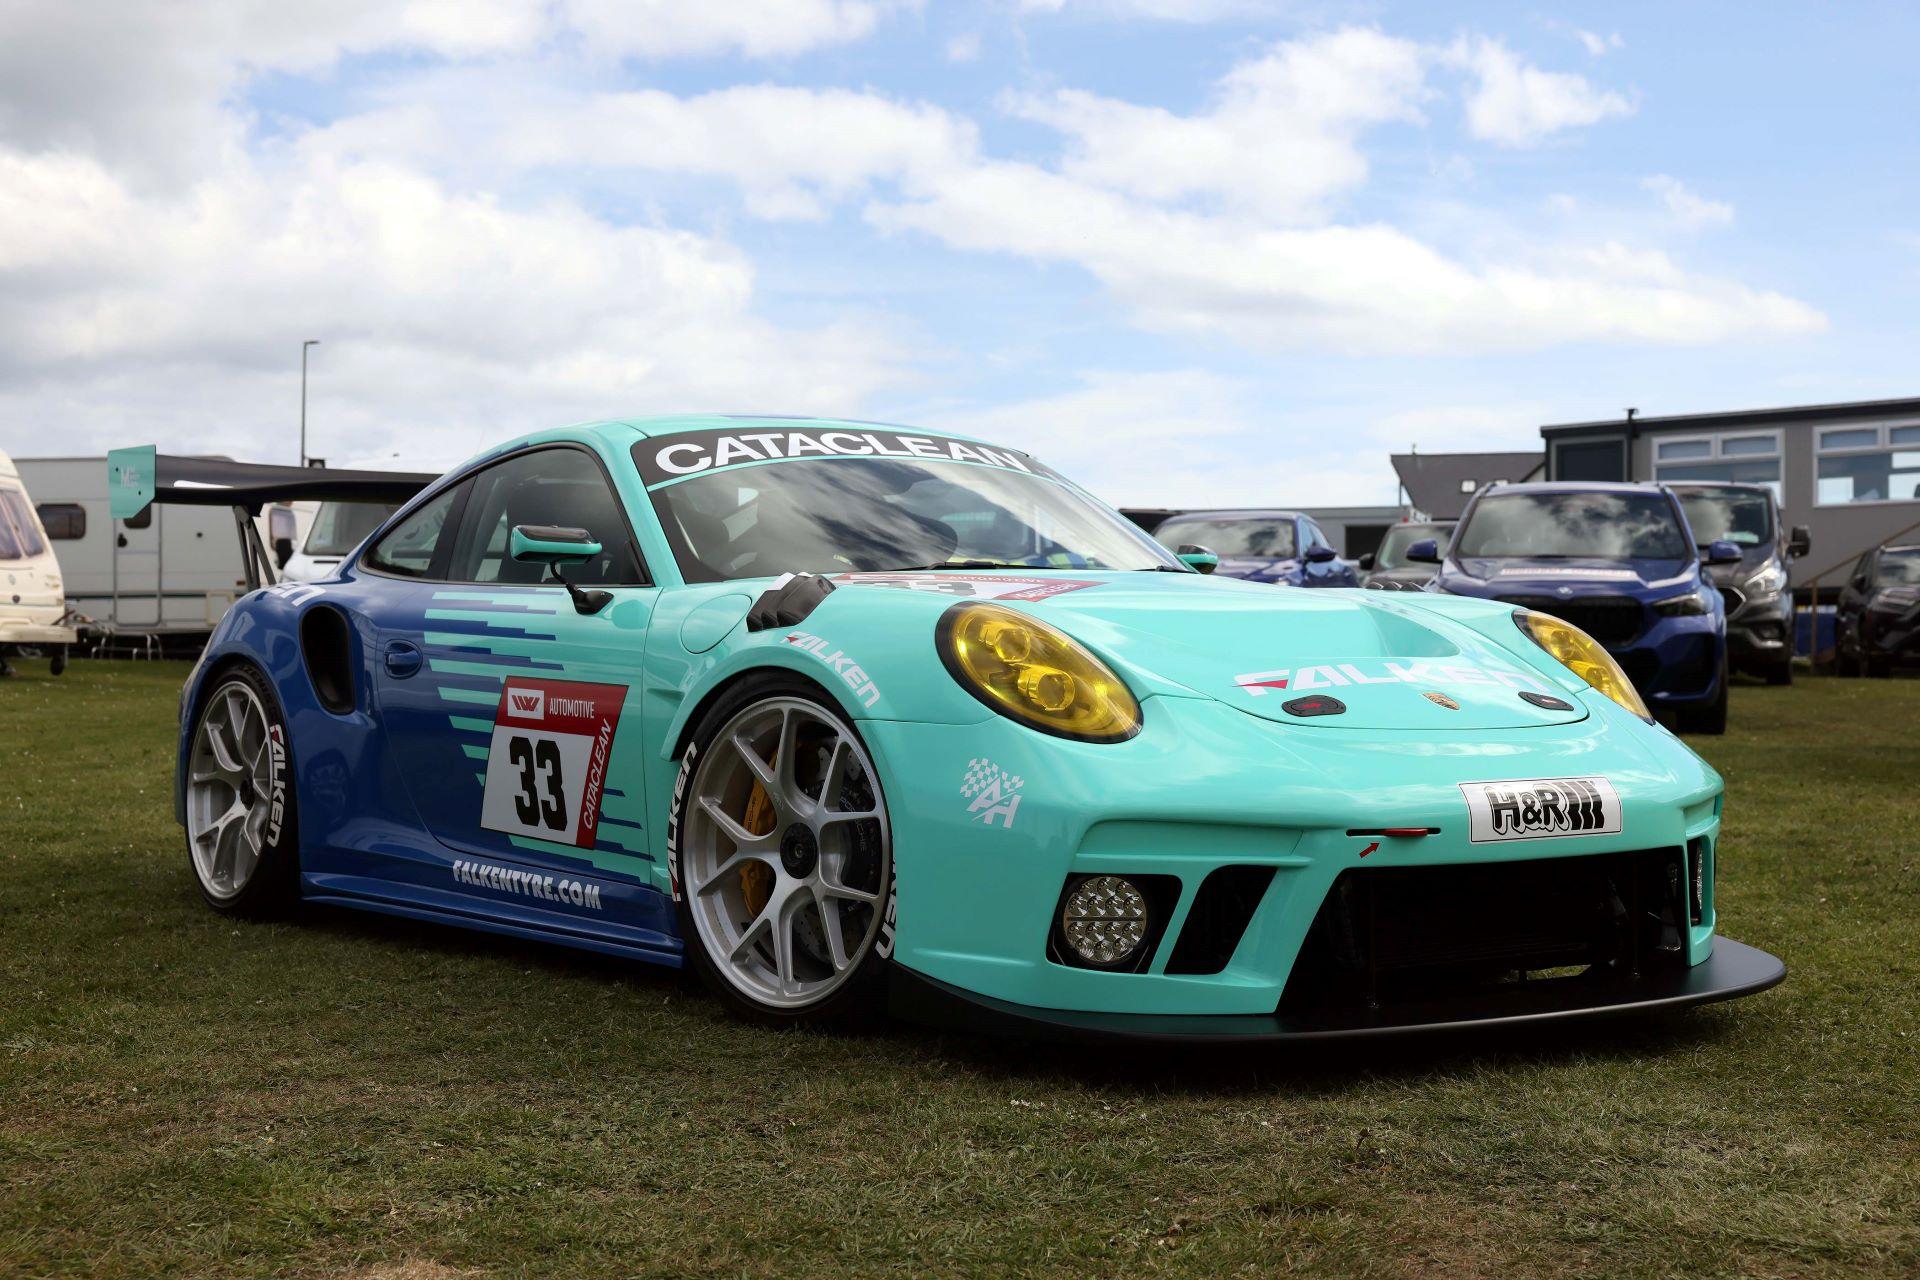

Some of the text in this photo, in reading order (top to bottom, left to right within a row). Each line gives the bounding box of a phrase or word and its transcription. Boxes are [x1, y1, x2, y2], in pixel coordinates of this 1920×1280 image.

[655, 432, 1032, 474] CATACLEAN
[780, 630, 881, 709] FALKEN
[1231, 662, 1552, 697] FALKEN
[549, 697, 595, 720] AUTOMOTIVE
[267, 723, 286, 848] FALKEN
[509, 736, 568, 832] 33
[583, 718, 612, 830] CATACLEAN
[452, 859, 603, 910] FALKENTYRE.COM
